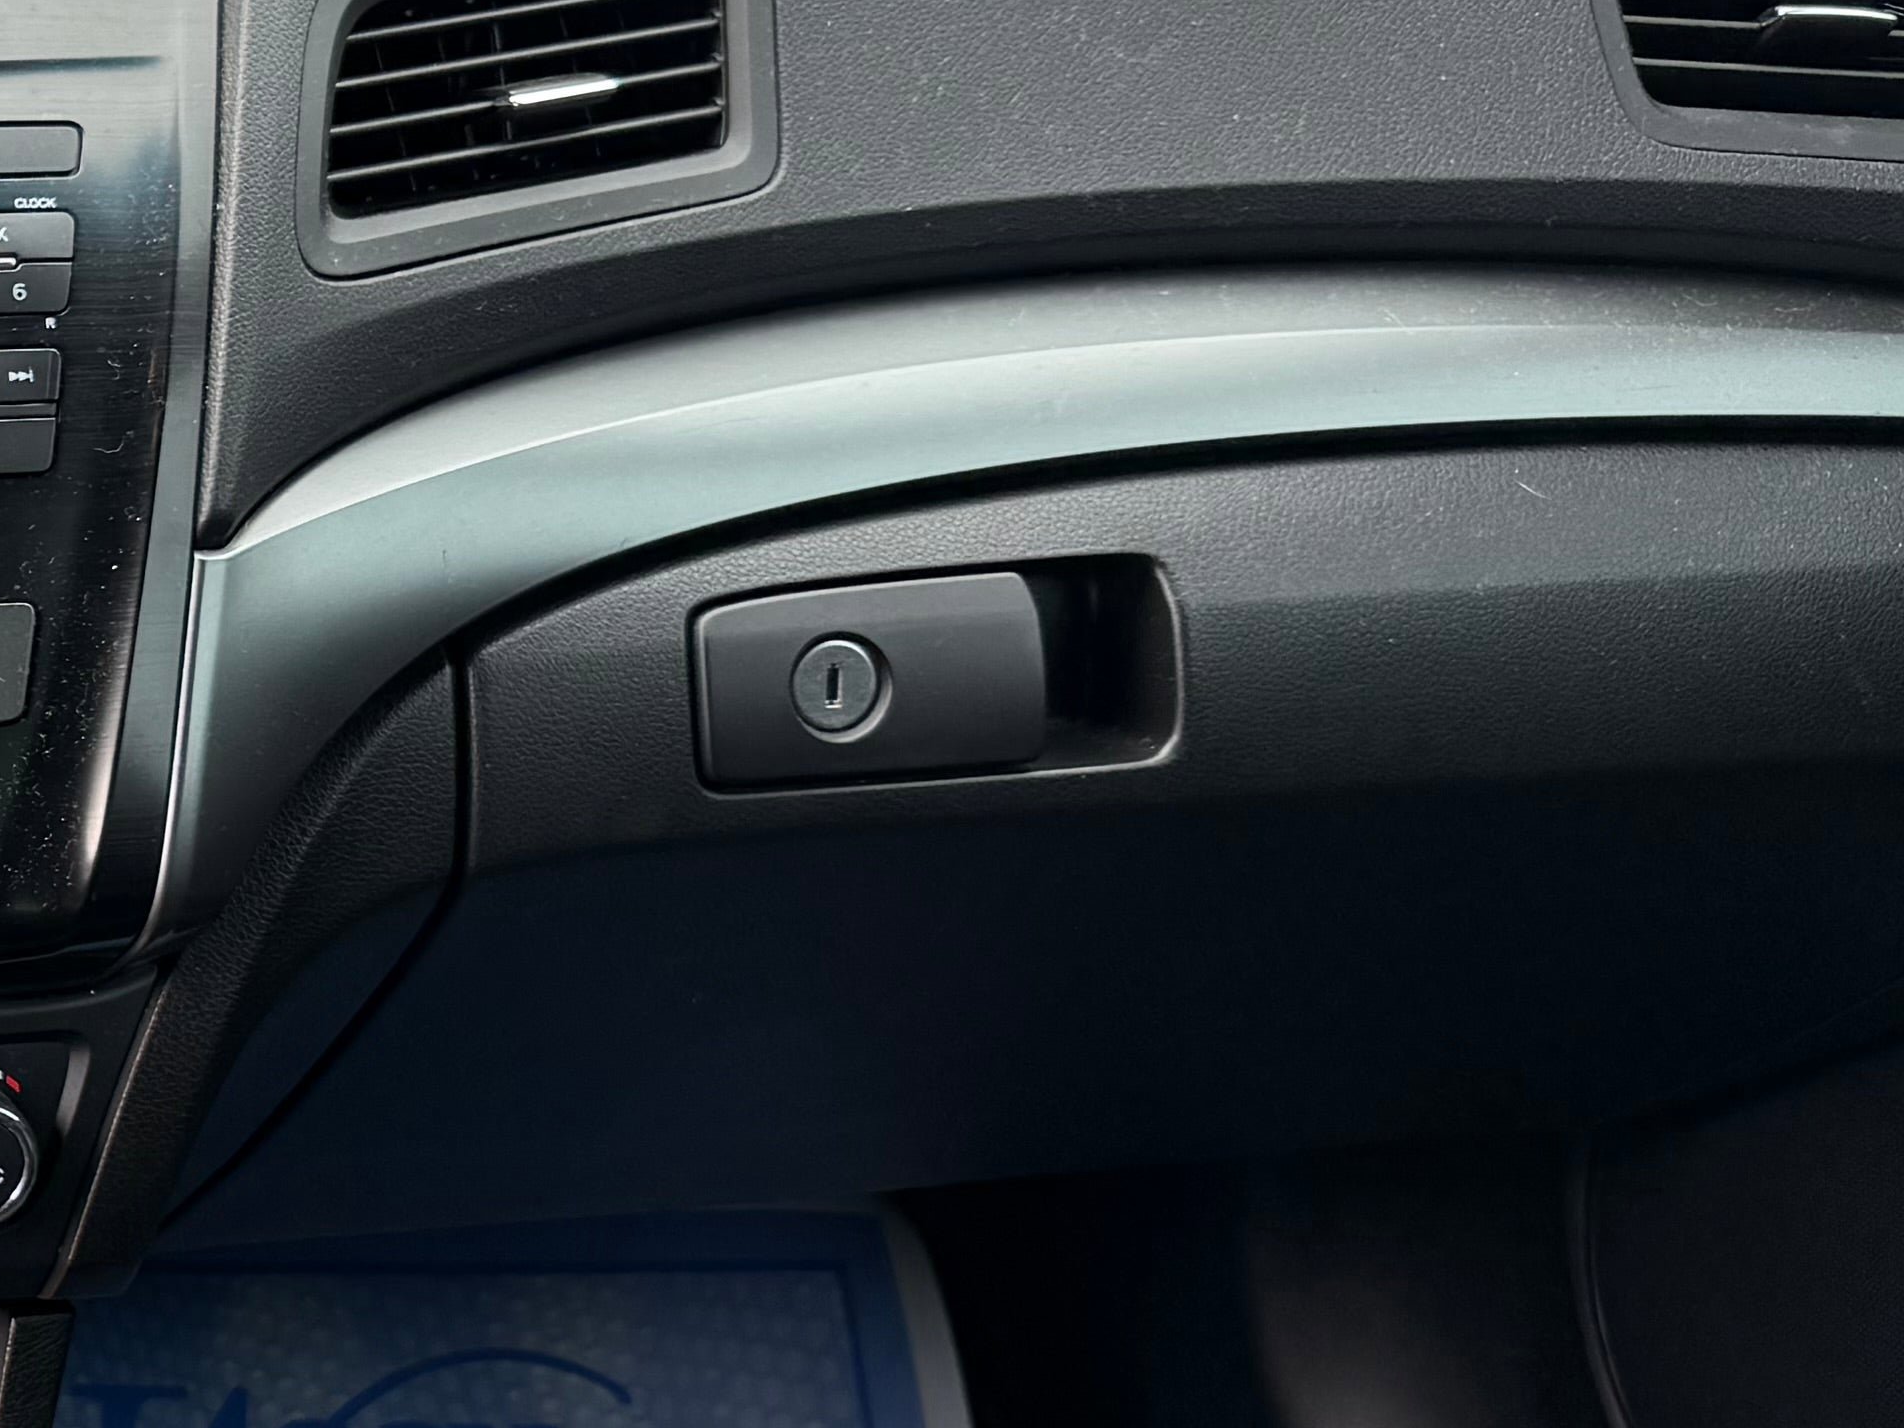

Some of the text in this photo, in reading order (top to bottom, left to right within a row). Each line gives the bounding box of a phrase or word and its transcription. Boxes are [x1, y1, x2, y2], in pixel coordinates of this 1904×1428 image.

[13, 197, 57, 209] CLOCK
[12, 283, 27, 301] 6
[45, 317, 56, 330] R
